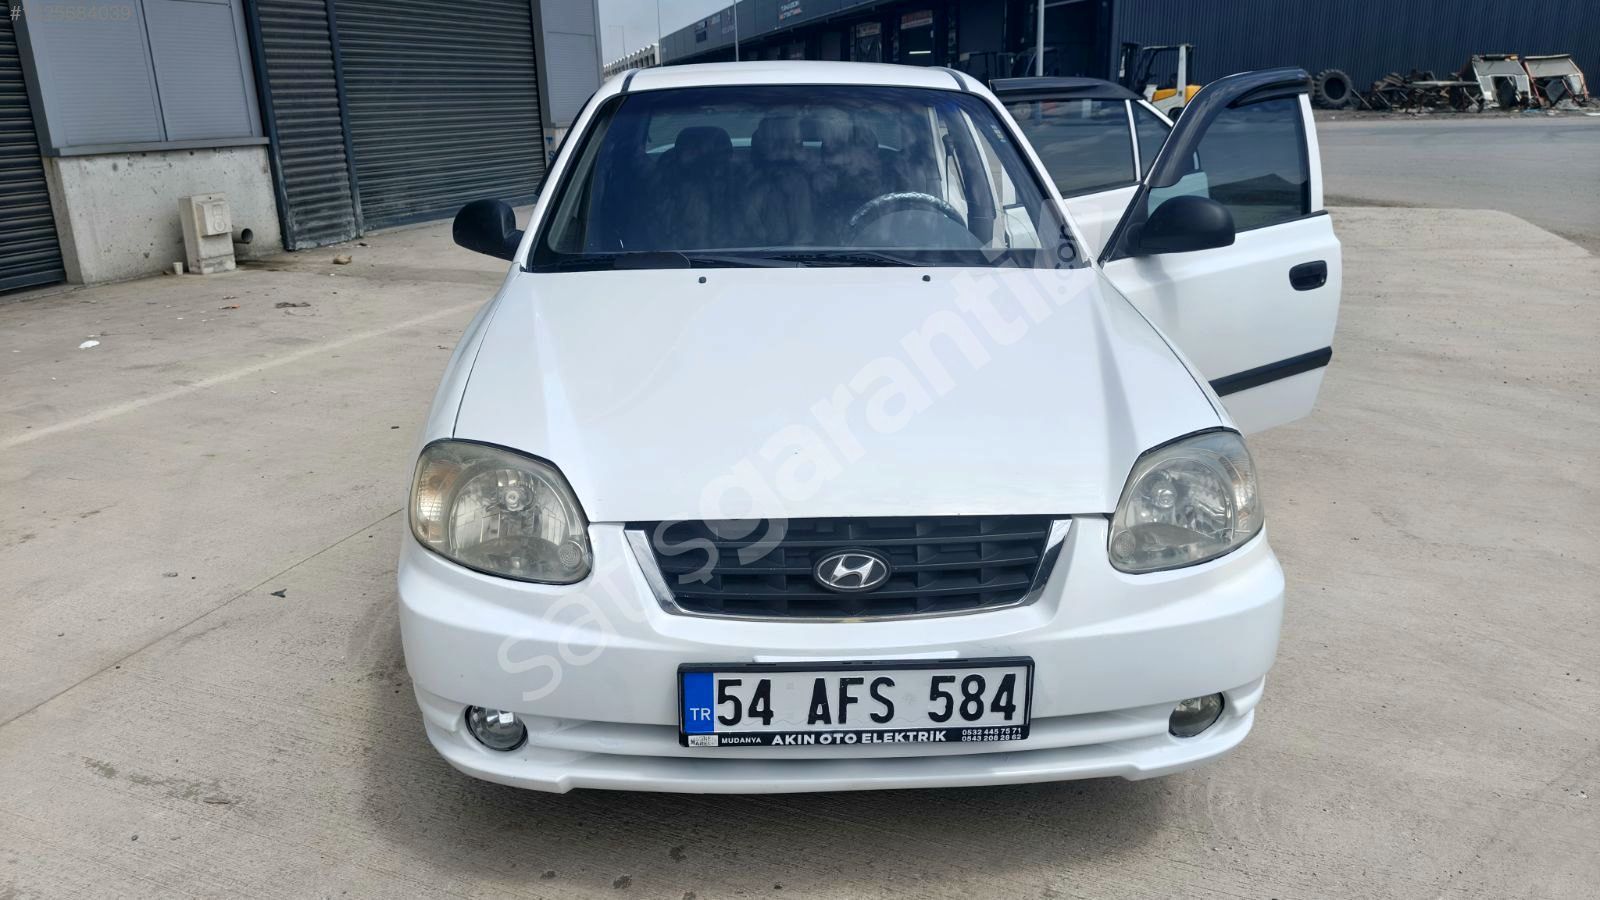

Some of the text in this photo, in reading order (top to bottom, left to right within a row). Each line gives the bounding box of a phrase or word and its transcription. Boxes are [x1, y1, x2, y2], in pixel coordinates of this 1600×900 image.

[717, 673, 1017, 727] 54 AFS 584
[689, 707, 712, 721] TR
[721, 730, 947, 746] MUDANYA AKIN OTO ELEKTRİK
